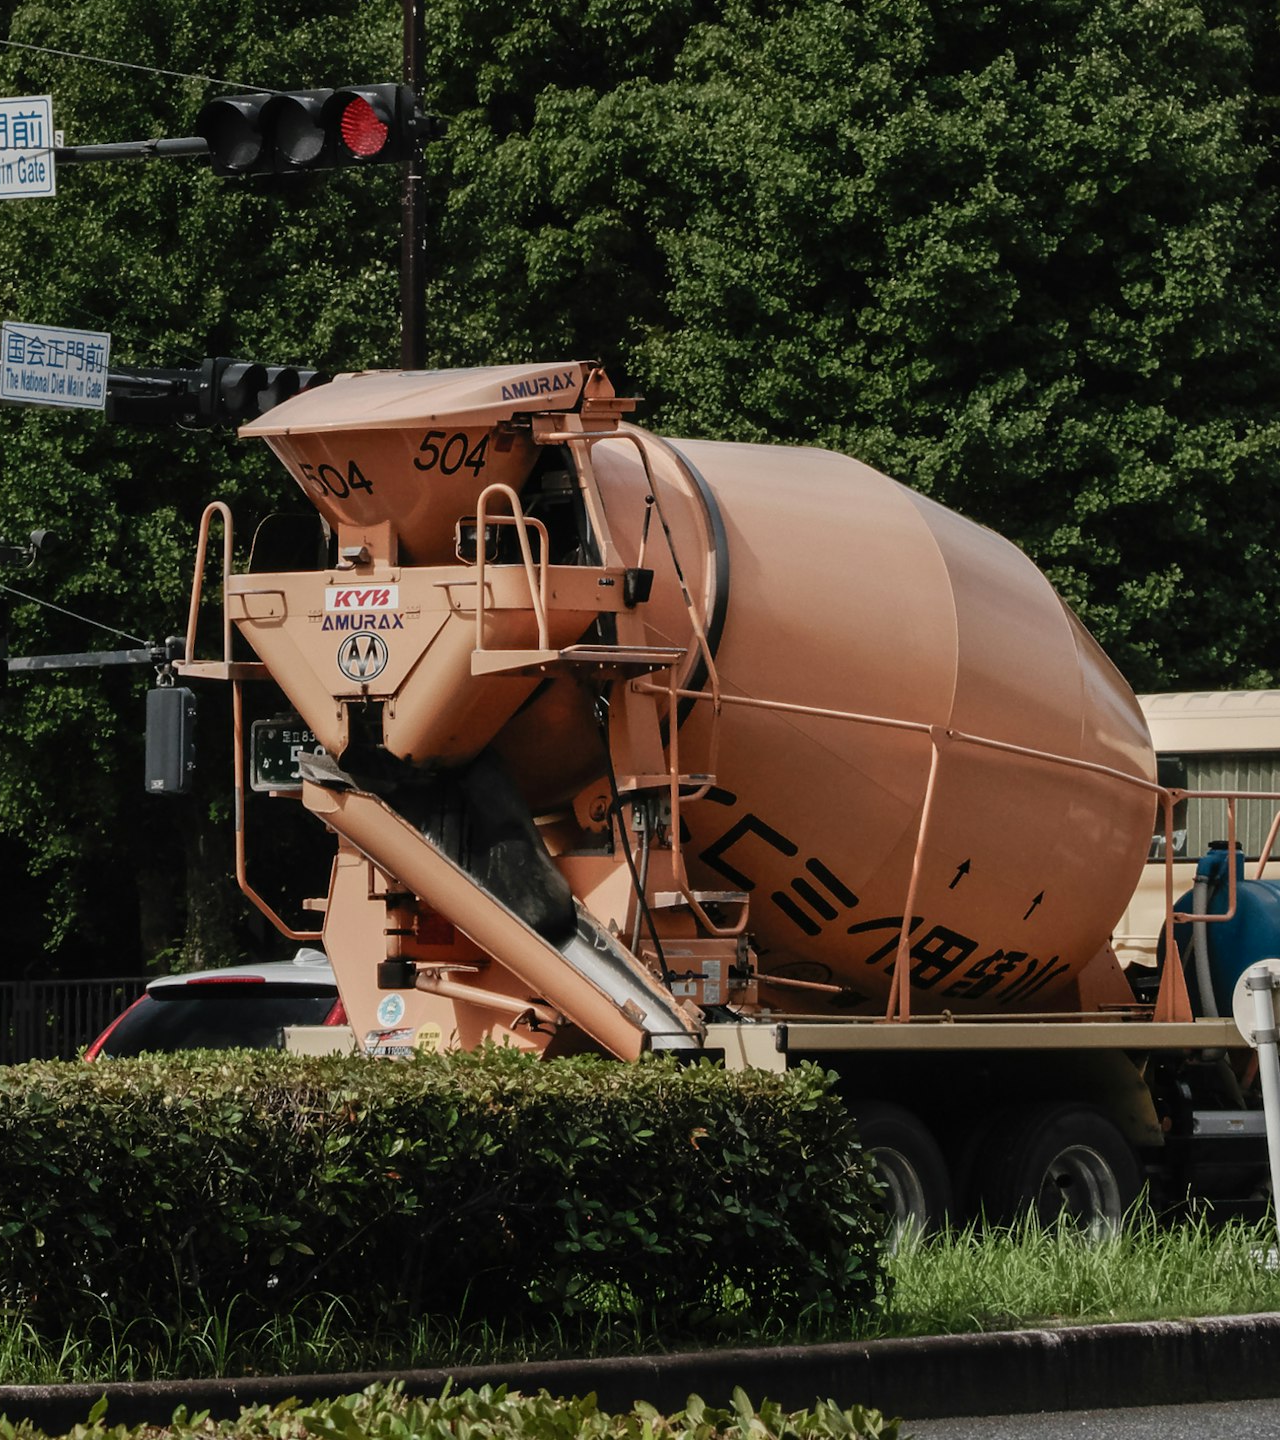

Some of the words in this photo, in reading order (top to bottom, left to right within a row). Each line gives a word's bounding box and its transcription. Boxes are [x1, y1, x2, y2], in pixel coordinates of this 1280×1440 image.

[17, 155, 46, 184] Gate
[7, 333, 105, 374] 国会正門前
[6, 367, 19, 390] The
[21, 369, 50, 393] National
[51, 372, 65, 395] Diet
[67, 374, 84, 397] Main
[86, 376, 102, 399] Gate
[501, 371, 576, 402] AMURAX
[412, 430, 490, 478] 504
[299, 458, 374, 500] 504
[332, 589, 391, 609] KYB
[321, 613, 405, 632] AMURAX
